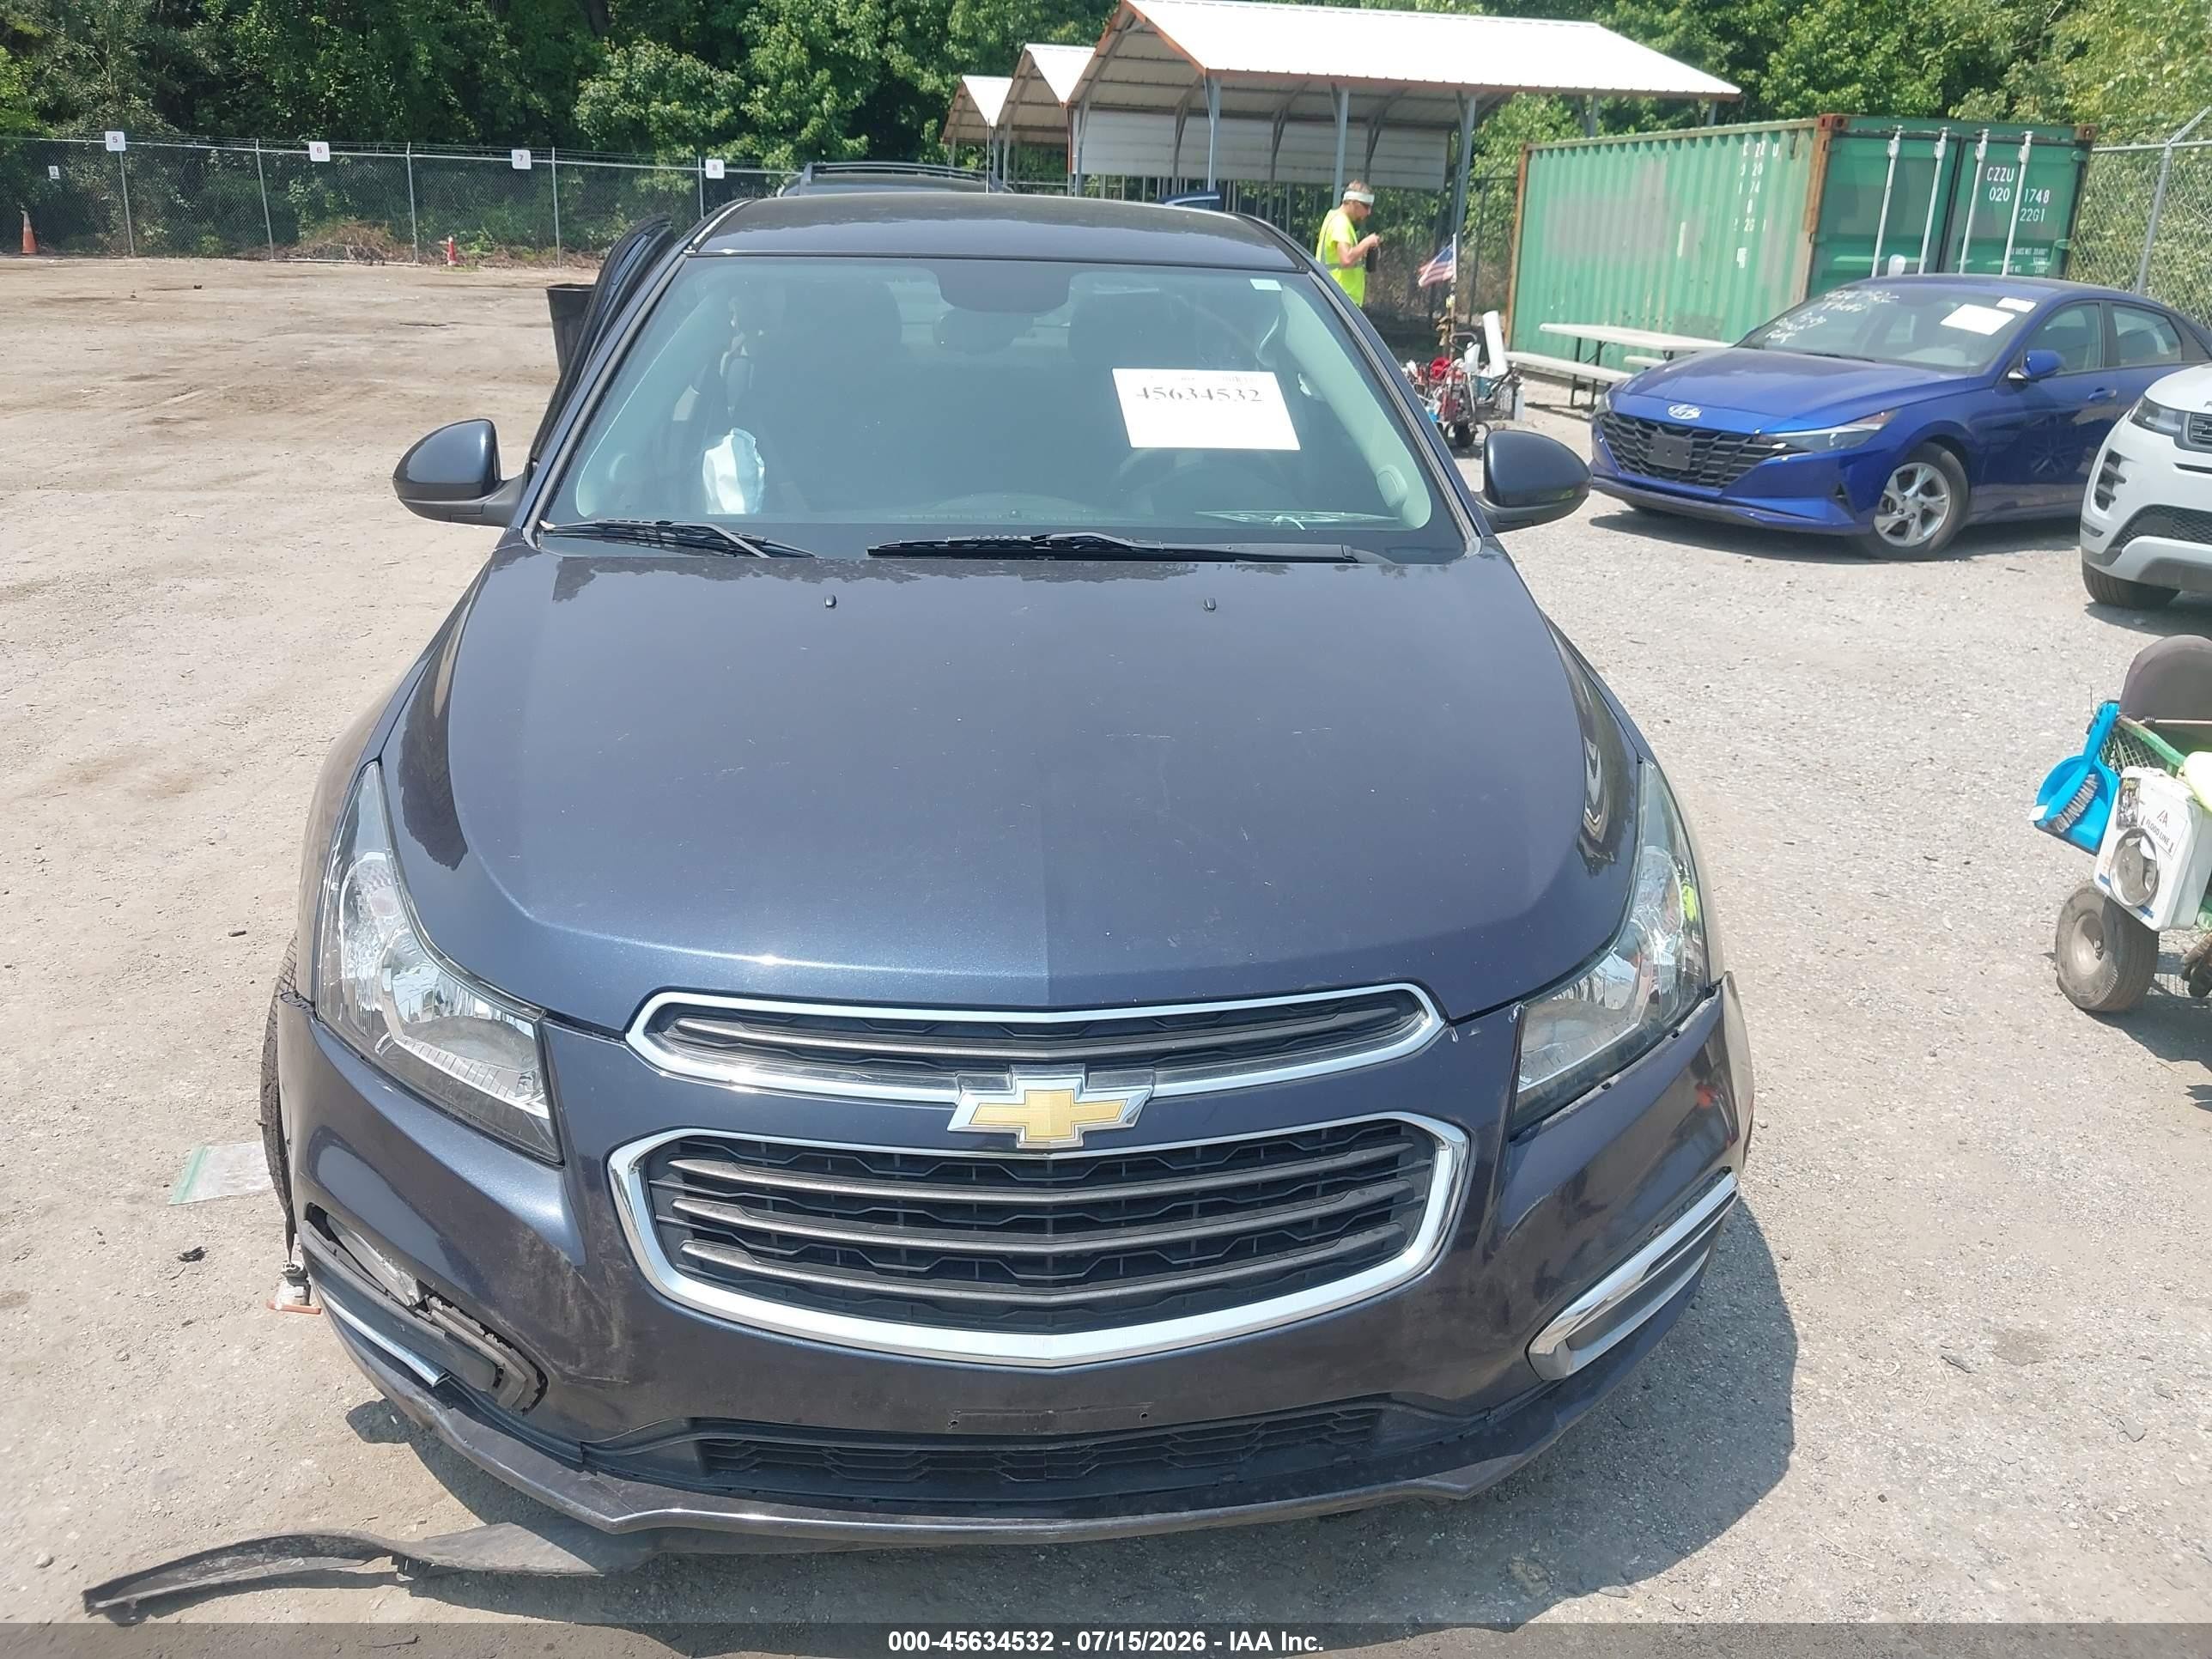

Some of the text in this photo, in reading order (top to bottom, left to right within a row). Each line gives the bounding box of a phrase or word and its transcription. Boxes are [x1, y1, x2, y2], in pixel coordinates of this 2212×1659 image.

[1986, 167, 2015, 183] CZZU
[1989, 186, 2051, 204] 020 1748
[2019, 208, 2045, 222] 22G1
[1136, 386, 1264, 402] 45634532
